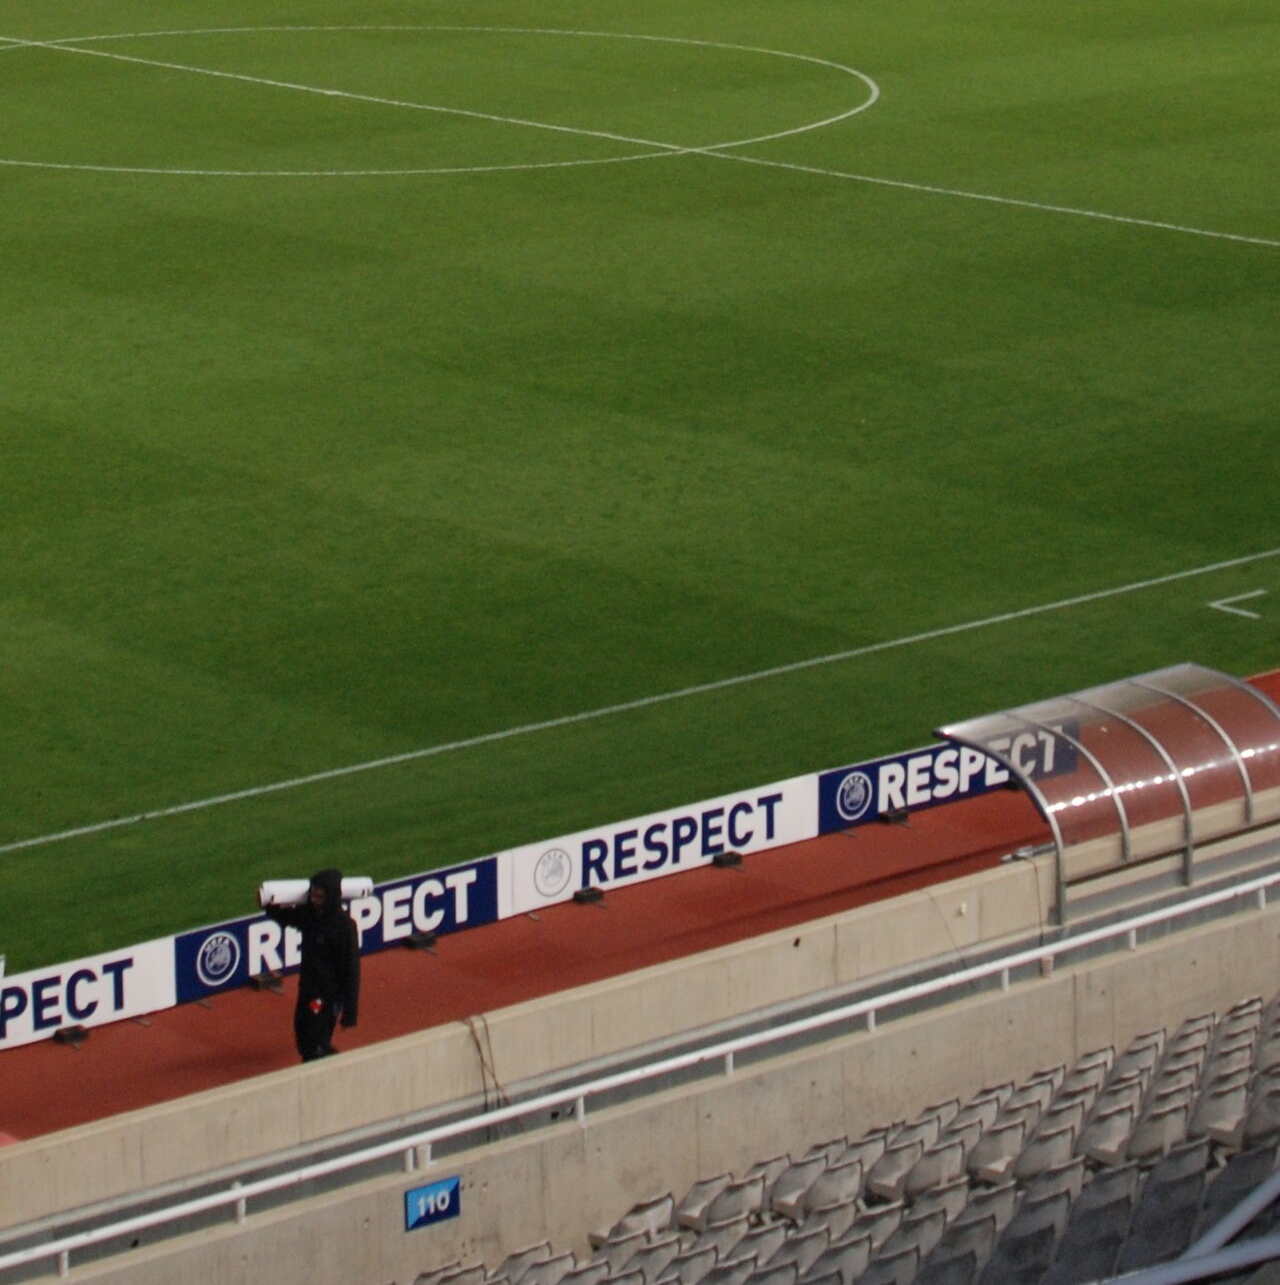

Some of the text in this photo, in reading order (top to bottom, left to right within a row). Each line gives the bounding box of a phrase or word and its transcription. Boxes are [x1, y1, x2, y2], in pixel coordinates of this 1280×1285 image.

[878, 725, 1063, 813] RESPECT
[581, 792, 783, 888] RESPECT
[248, 868, 477, 977] REPECT
[417, 1190, 451, 1217] 110
